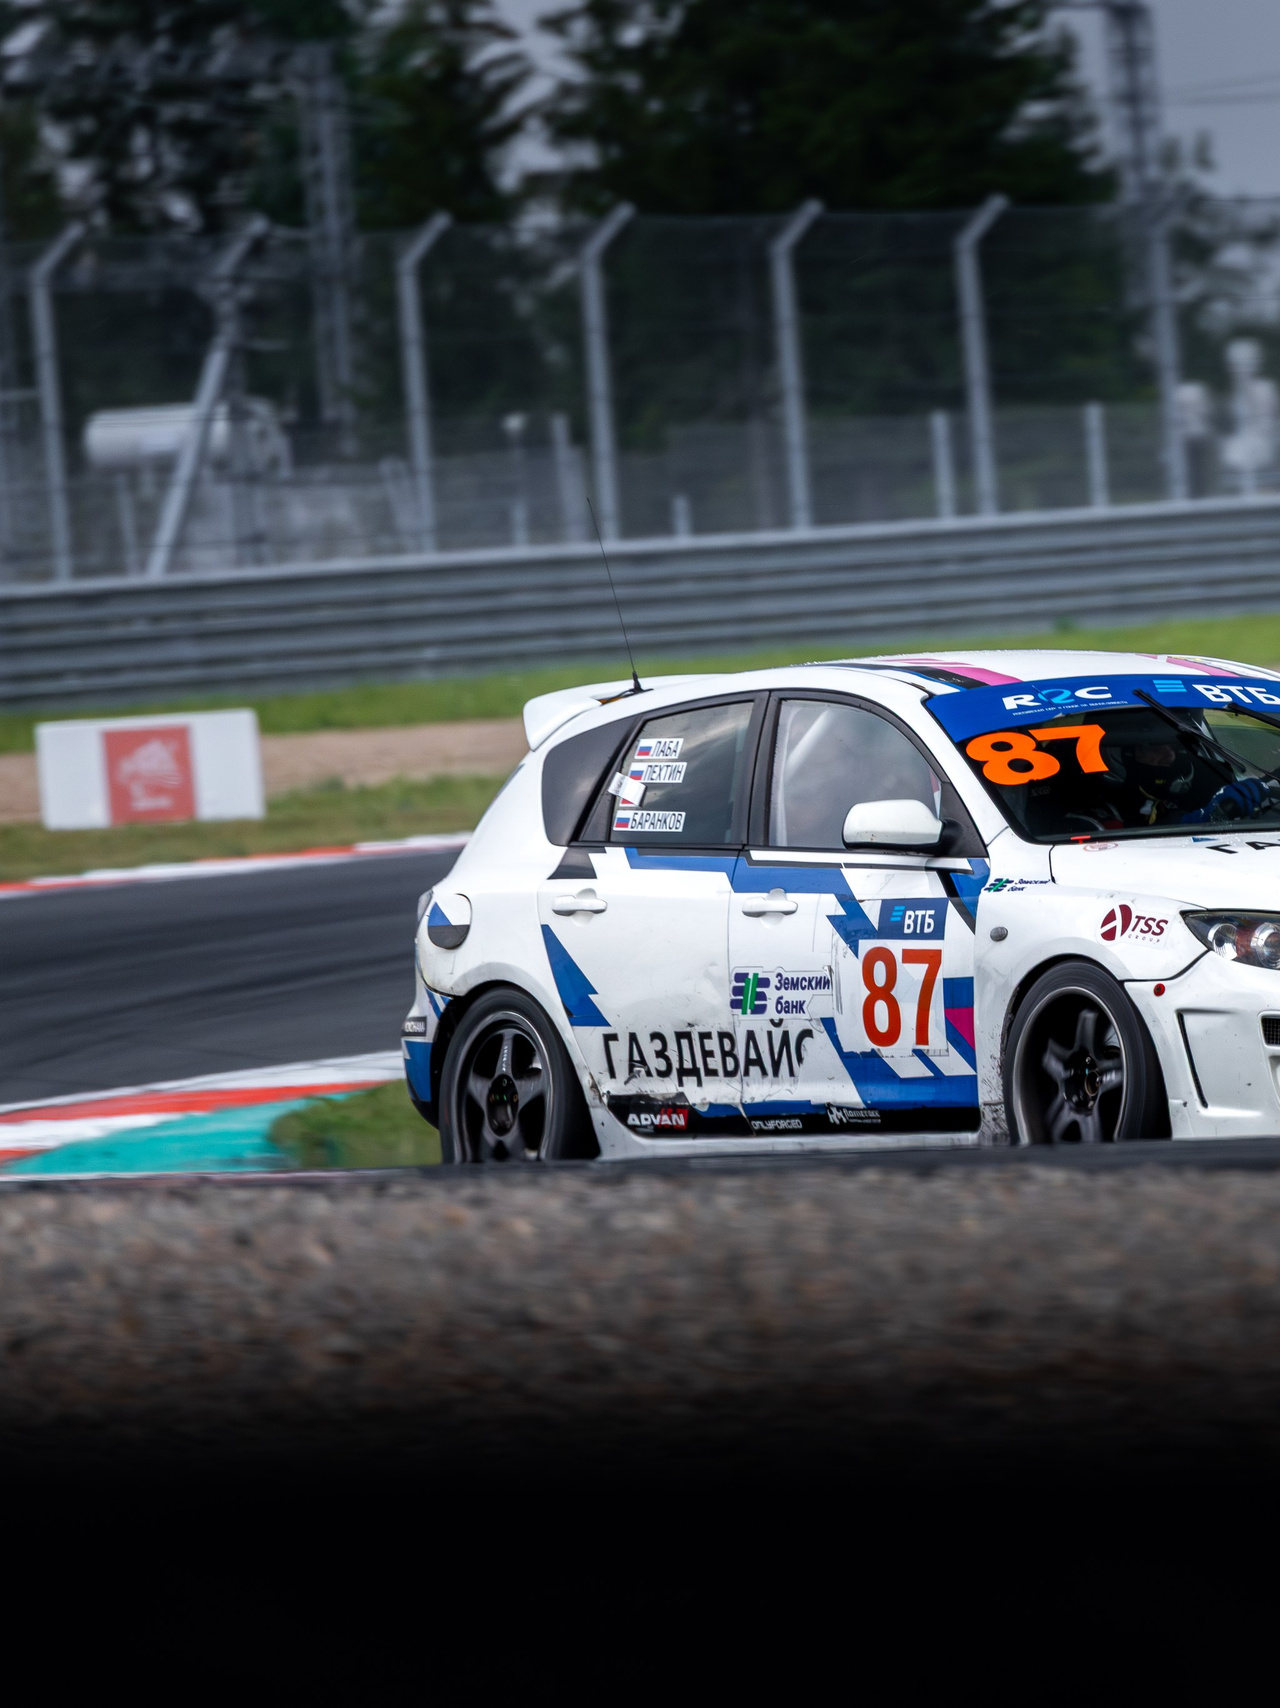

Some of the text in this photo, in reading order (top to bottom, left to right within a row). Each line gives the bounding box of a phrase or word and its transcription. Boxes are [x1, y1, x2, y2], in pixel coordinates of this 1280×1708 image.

[650, 740, 680, 757] ЛАБА
[966, 724, 1109, 786] 87
[643, 764, 684, 781] ПЕХТИН
[630, 812, 683, 830] БАРАНКОВ
[903, 910, 936, 934] ВТБ
[1131, 915, 1169, 937] TSS
[1127, 934, 1161, 944] GROUP
[775, 995, 806, 1015] банк
[862, 946, 942, 1047] 87
[627, 1113, 685, 1126] ADVAN
